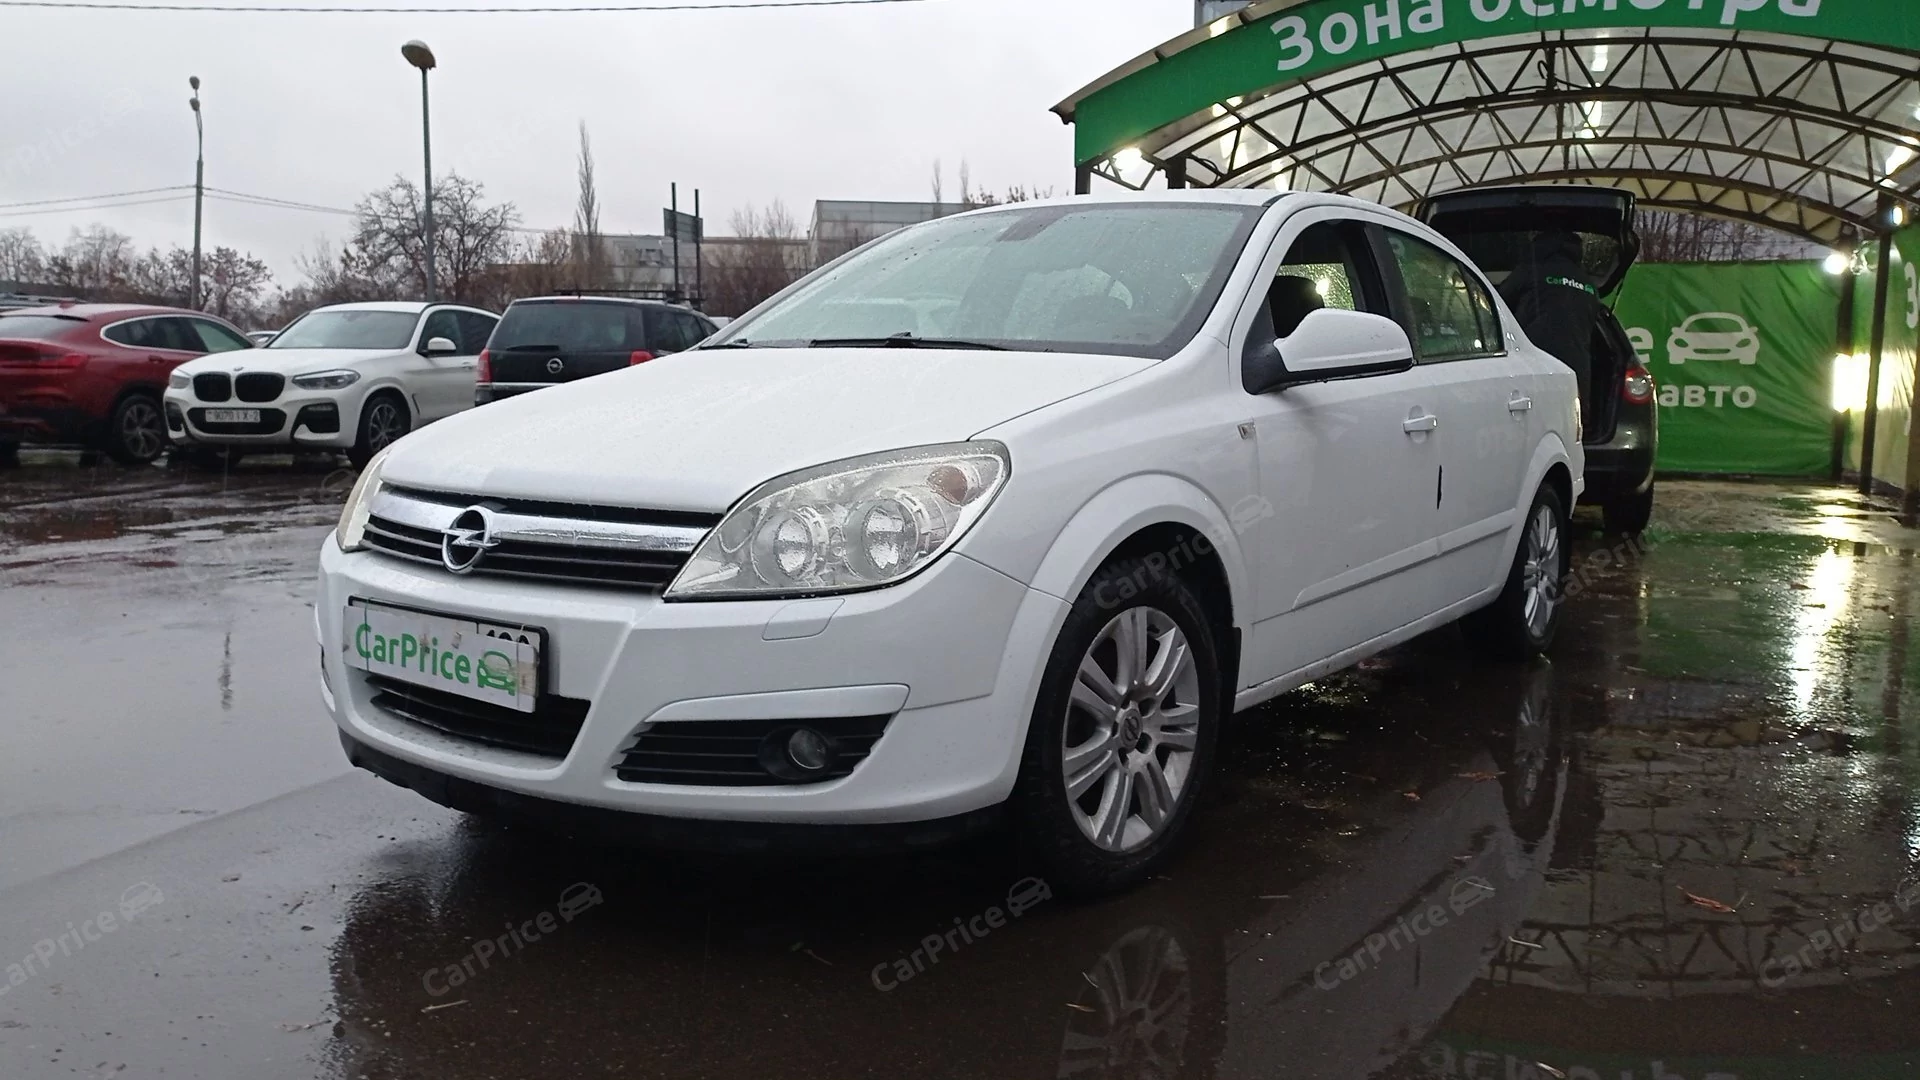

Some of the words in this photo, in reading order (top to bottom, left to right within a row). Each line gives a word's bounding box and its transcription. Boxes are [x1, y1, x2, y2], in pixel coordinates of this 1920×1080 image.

[1270, 0, 1444, 71] Зона
[1659, 384, 1757, 409] авто
[355, 622, 471, 684] CarPrice
